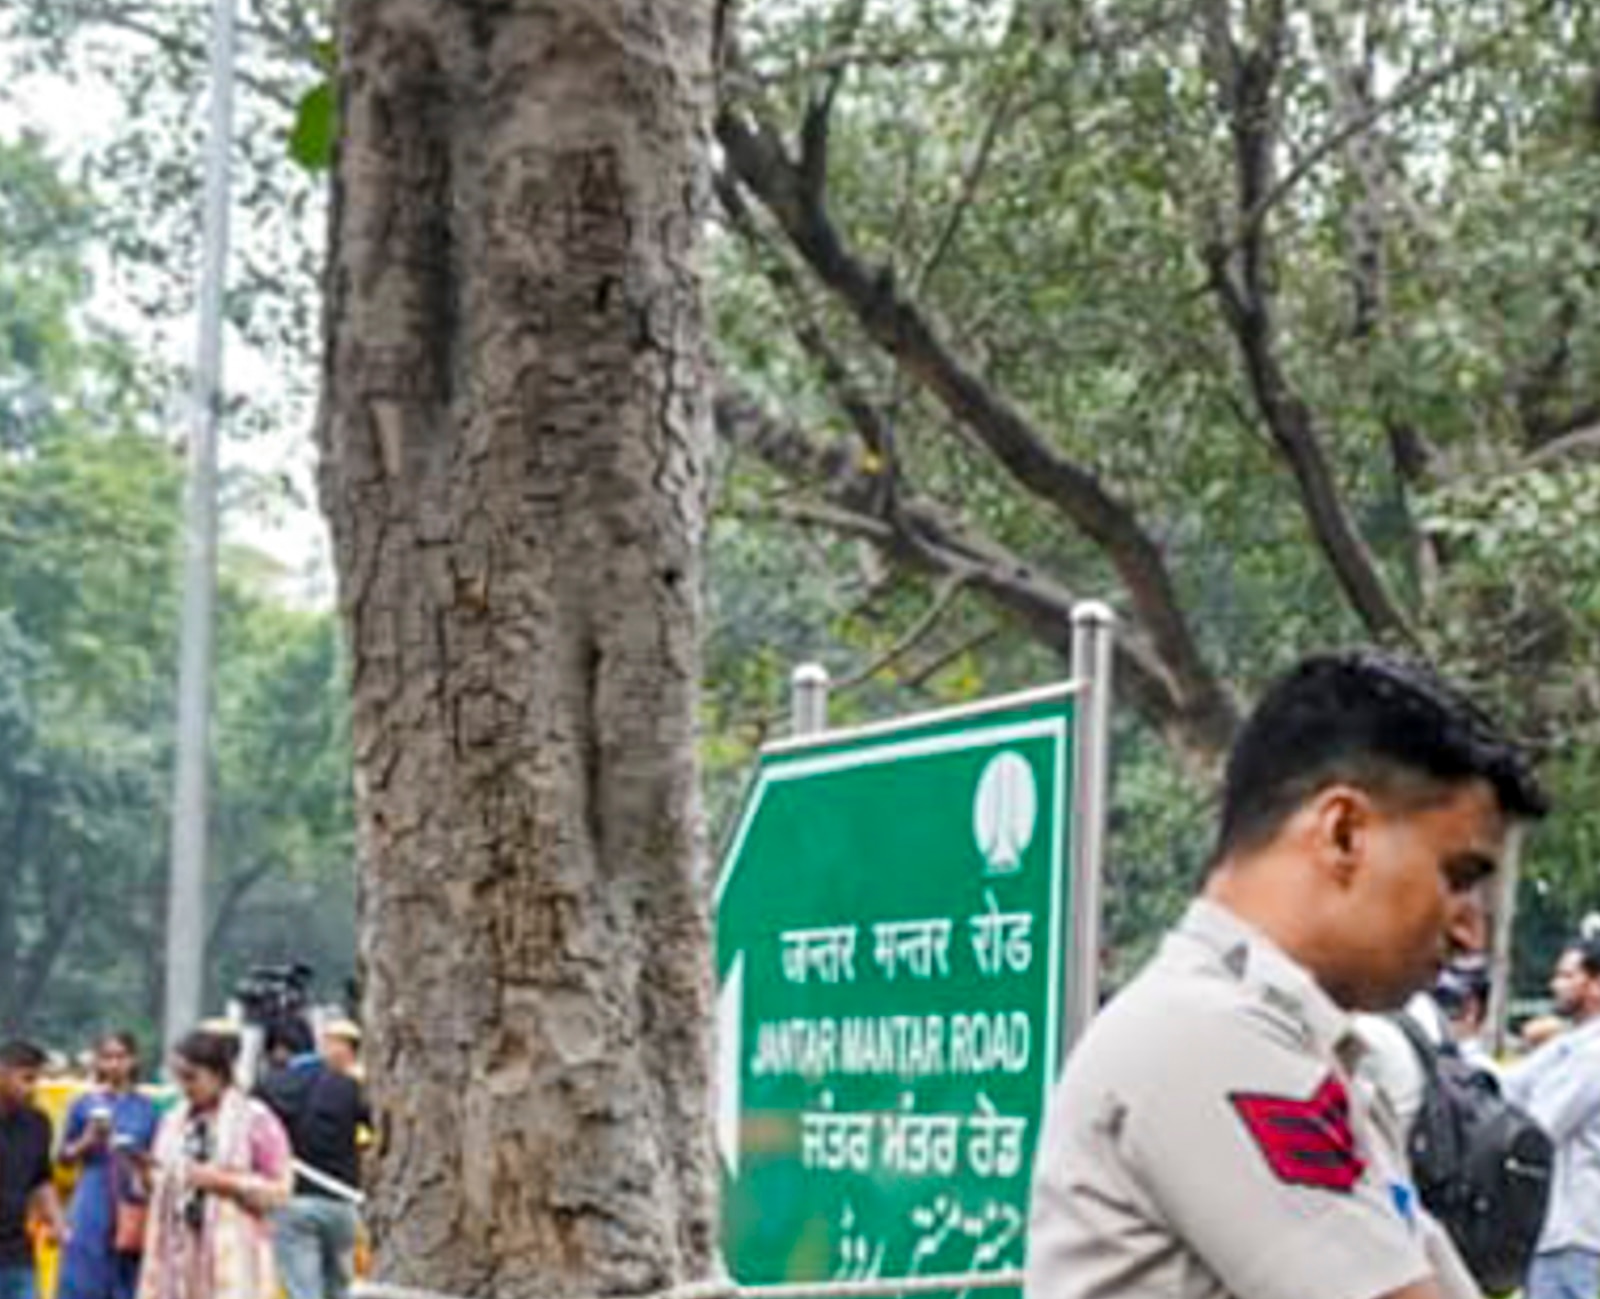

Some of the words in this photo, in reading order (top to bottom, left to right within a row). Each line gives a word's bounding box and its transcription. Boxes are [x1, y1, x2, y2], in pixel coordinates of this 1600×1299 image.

[969, 889, 1033, 974] रोड
[751, 1017, 836, 1077] JANTAR
[840, 1014, 945, 1075] MANTAR
[950, 1011, 1031, 1073] ROAD
